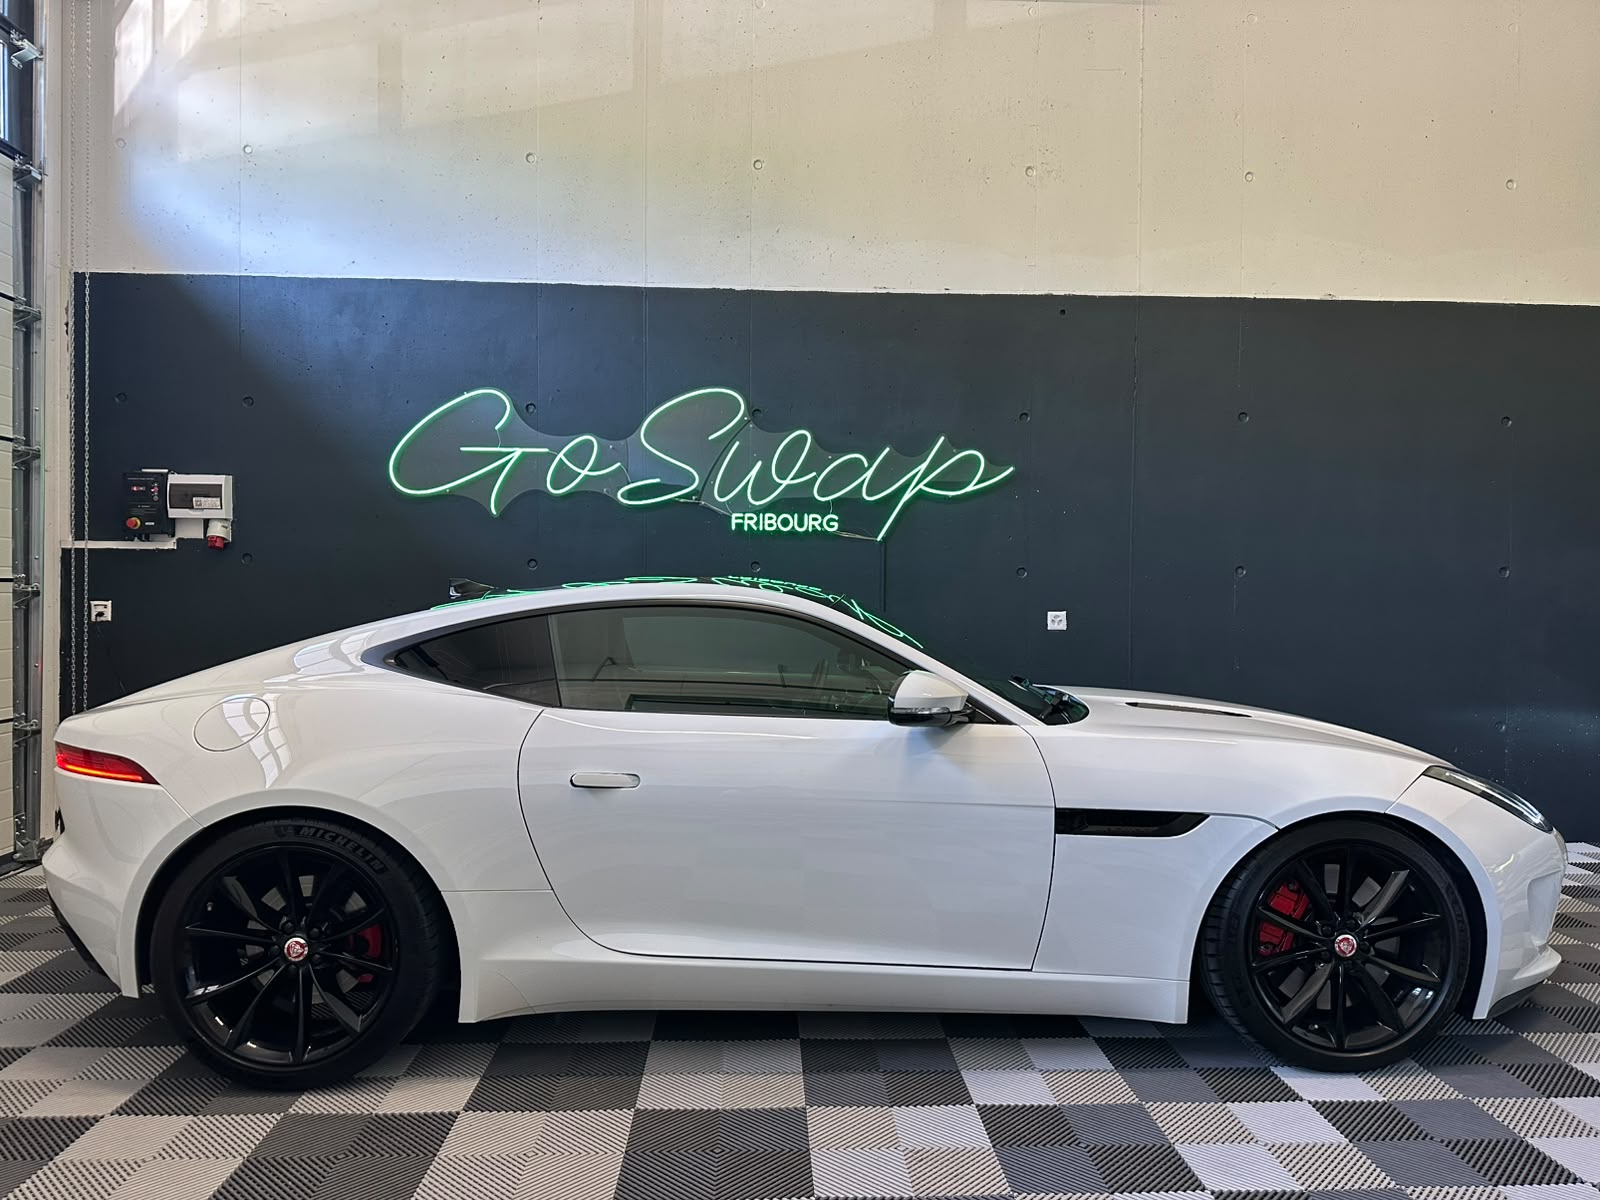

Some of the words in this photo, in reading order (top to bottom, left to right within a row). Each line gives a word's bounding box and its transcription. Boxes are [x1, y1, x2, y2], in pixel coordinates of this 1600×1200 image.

[388, 388, 1015, 542] GoSwap
[731, 512, 839, 532] FRIBOURG
[297, 825, 386, 872] MICHELIN
